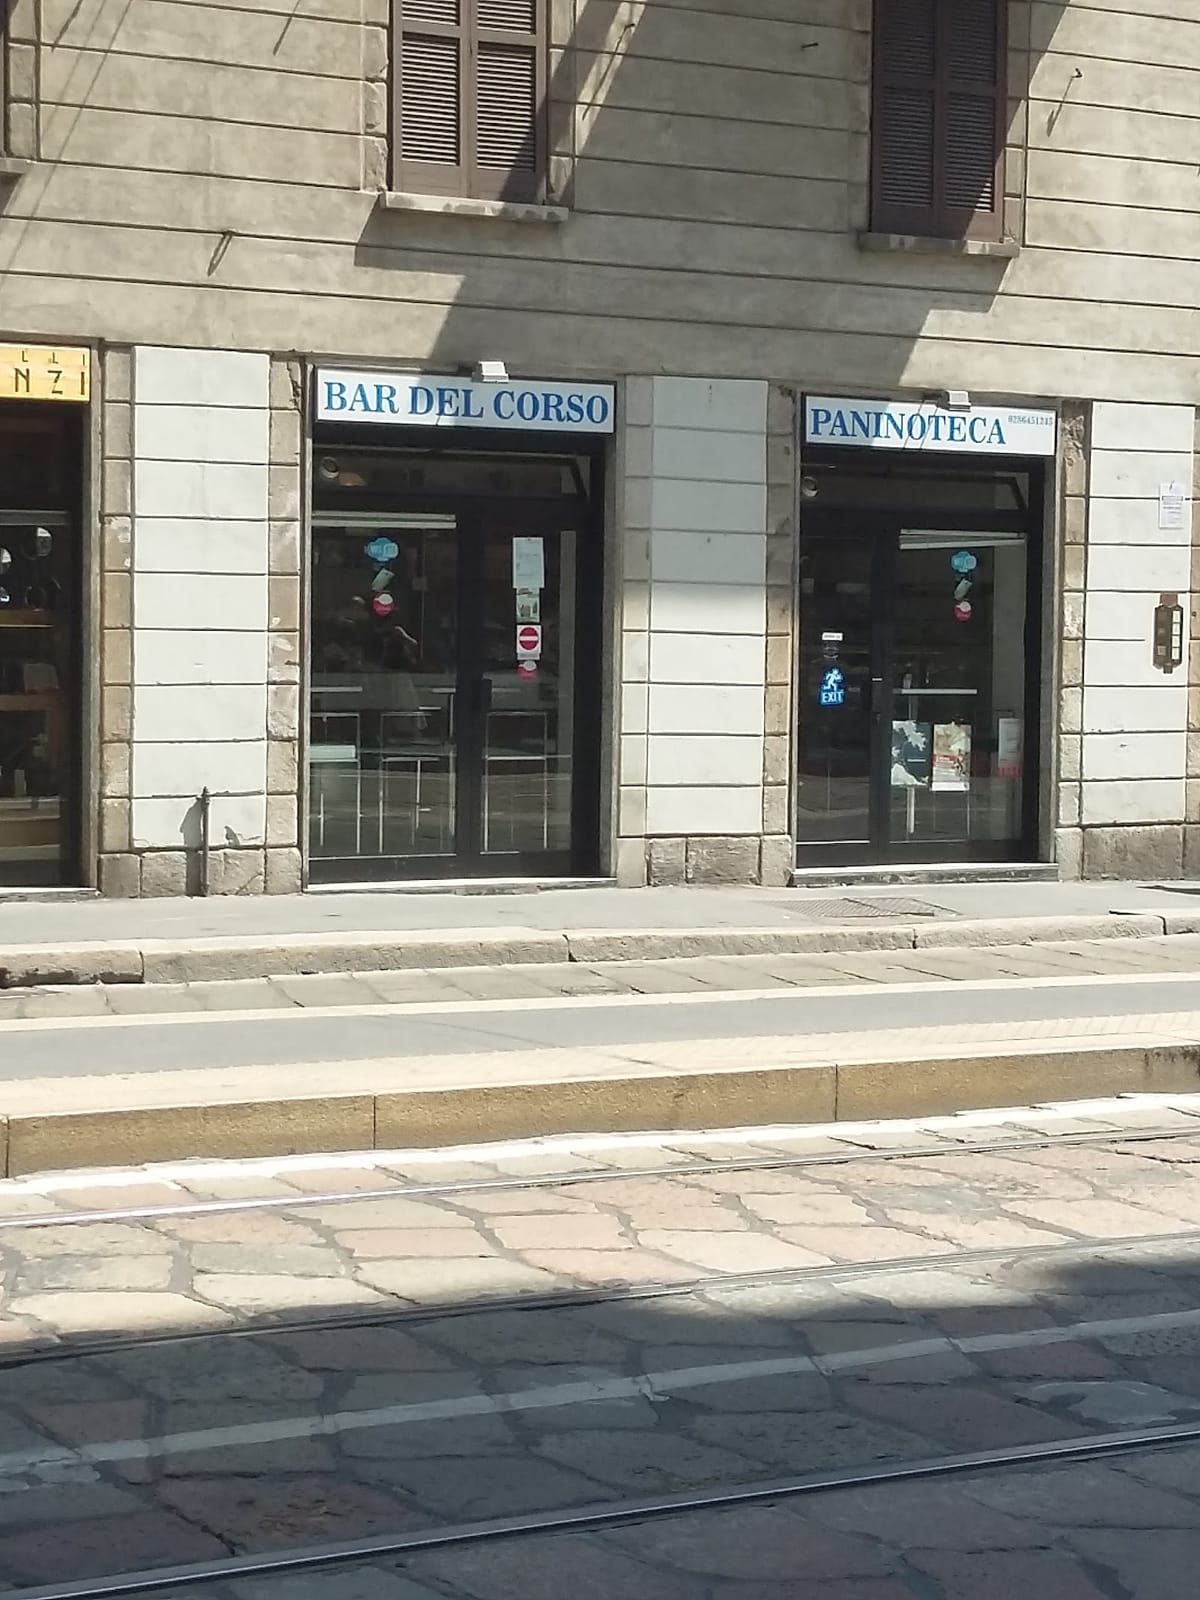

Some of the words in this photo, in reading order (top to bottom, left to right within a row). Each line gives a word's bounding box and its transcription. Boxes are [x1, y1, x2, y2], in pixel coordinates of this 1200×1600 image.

[324, 381, 399, 414] BAR
[408, 386, 484, 418] DEL
[493, 390, 609, 424] CORSO
[810, 408, 1006, 444] PANINOTECA
[822, 692, 844, 703] EXIT
